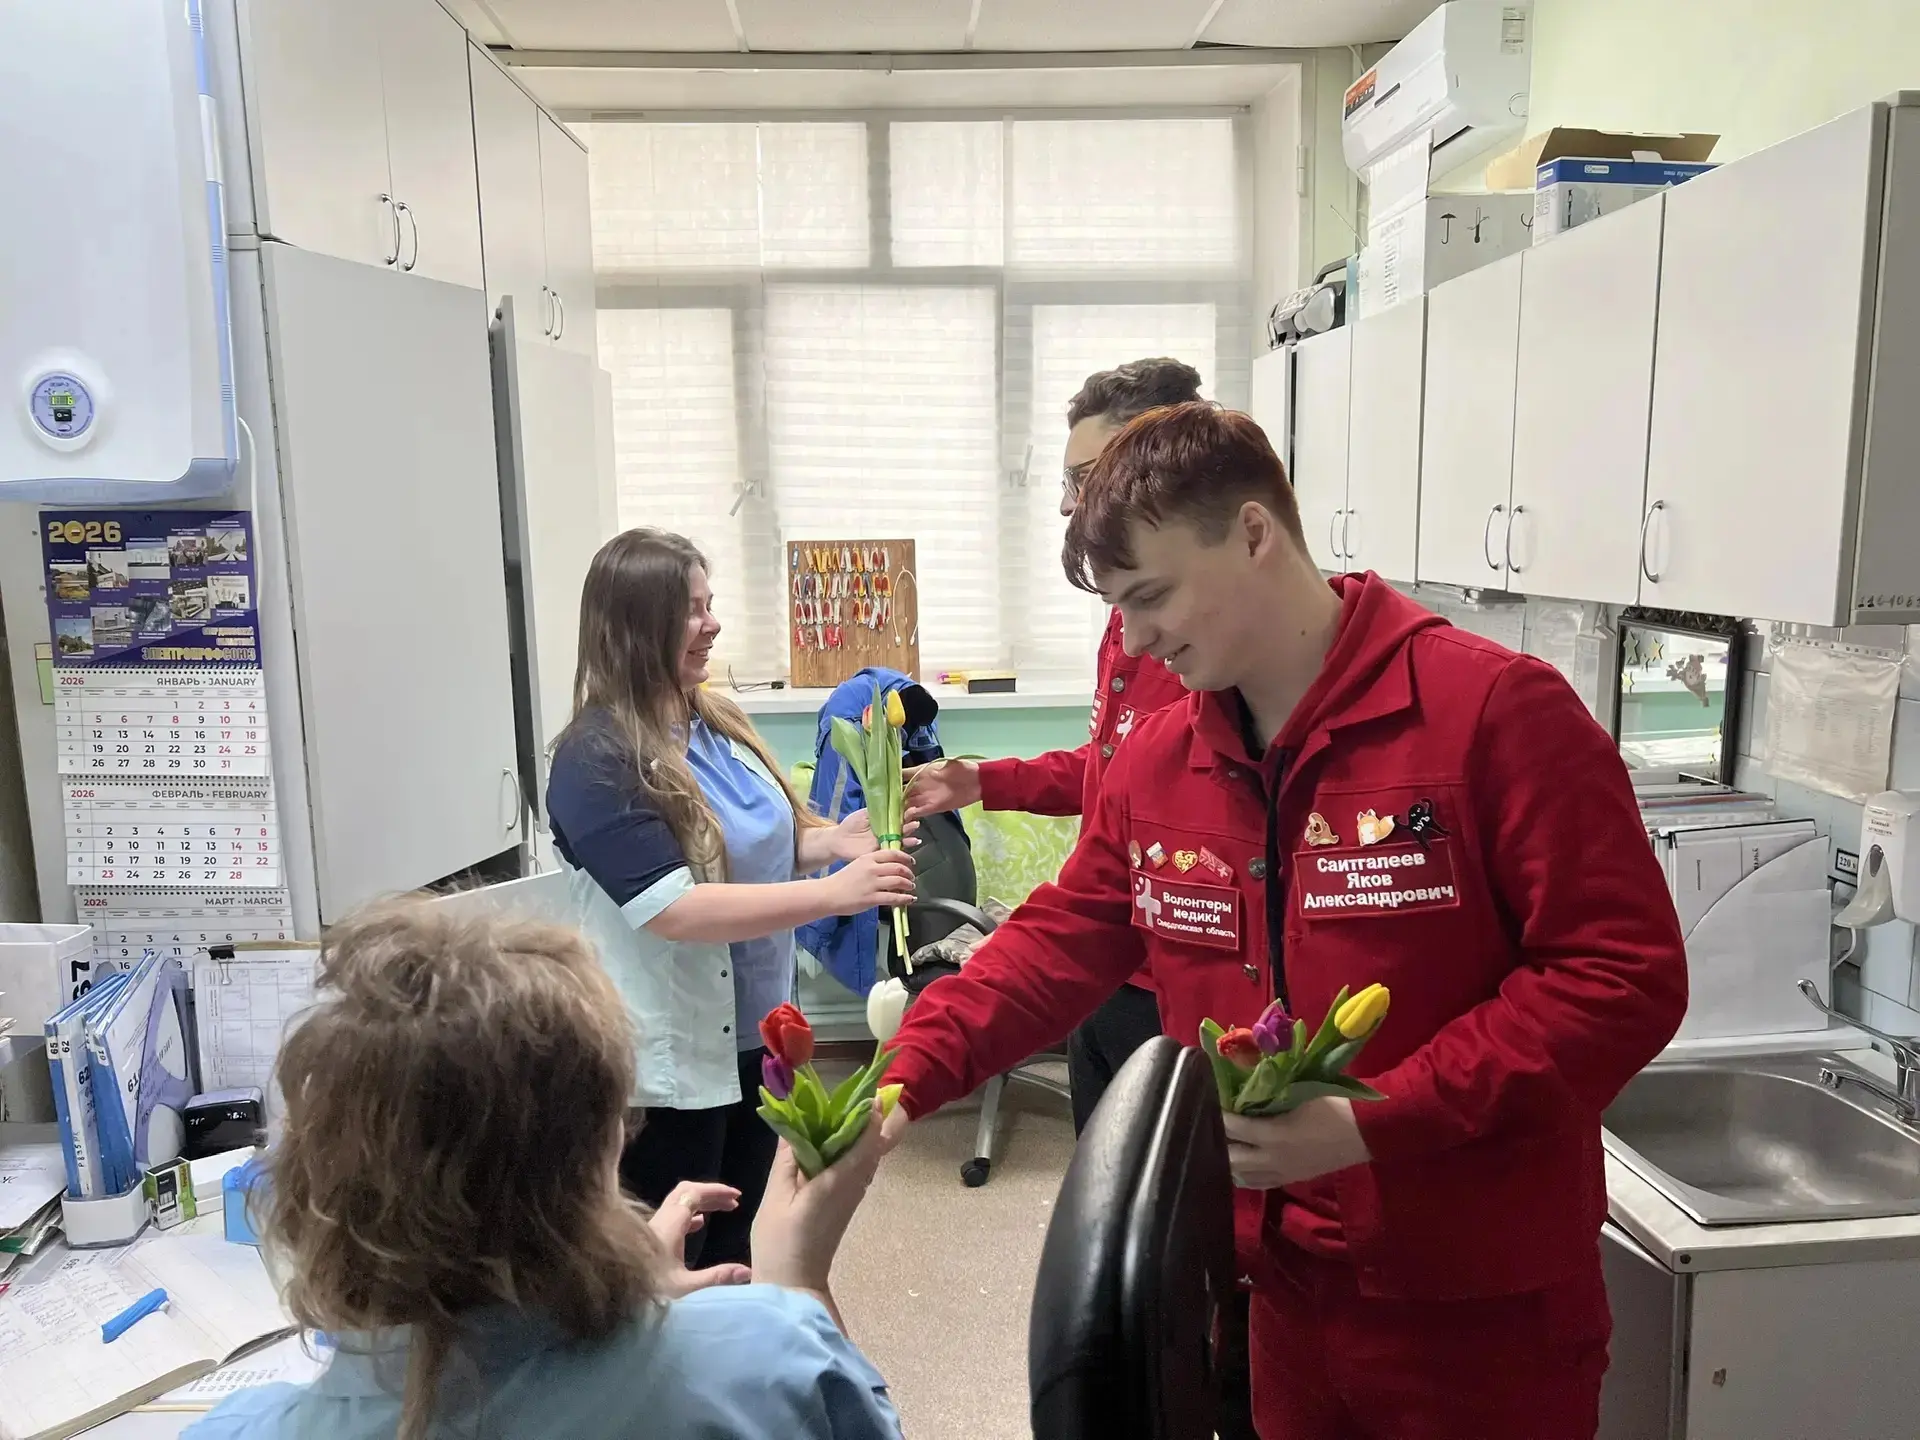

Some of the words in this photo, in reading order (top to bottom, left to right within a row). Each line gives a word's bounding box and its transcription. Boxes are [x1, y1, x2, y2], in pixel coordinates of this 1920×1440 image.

[48, 521, 121, 543] 2026
[60, 677, 85, 685] 2026
[156, 677, 200, 686] ЯНВАРЬ
[208, 677, 257, 686] JANUARY
[219, 715, 231, 725] 10
[248, 715, 257, 725] 11
[92, 729, 103, 739] 12
[117, 730, 129, 739] 13
[142, 730, 154, 739] 14
[169, 730, 180, 739] 15
[194, 730, 206, 740] 16
[220, 730, 231, 740] 17
[245, 730, 257, 740] 18
[92, 744, 104, 753] 19
[116, 744, 130, 753] 20
[144, 744, 155, 753] 21
[168, 744, 181, 754] 22
[193, 744, 206, 754] 23
[218, 745, 231, 754] 24
[244, 745, 257, 755] 25
[91, 758, 105, 768] 26
[117, 758, 130, 768] 27
[142, 759, 156, 768] 28
[168, 759, 181, 768] 29
[192, 759, 206, 769] 30
[220, 759, 231, 769] 31
[70, 789, 95, 798] 2026
[152, 789, 204, 799] ФЕВРАЛЬ
[212, 790, 268, 799] FEBRUARY
[127, 840, 140, 851] 10
[156, 841, 165, 851] 11
[180, 841, 191, 851] 12
[206, 841, 217, 851] 13
[231, 841, 243, 851] 14
[257, 841, 268, 852] 15
[103, 855, 114, 865] 16
[128, 855, 140, 865] 17
[154, 856, 166, 865] 18
[179, 856, 191, 865] 19
[203, 856, 217, 865] 20
[232, 856, 243, 866] 21
[256, 856, 269, 866] 22
[1838, 856, 1852, 868] 220
[101, 869, 114, 879] 23
[126, 869, 140, 879] 24
[152, 870, 165, 879] 25
[178, 870, 191, 880] 26
[204, 870, 217, 880] 27
[229, 870, 243, 880] 28
[1346, 872, 1393, 889] Яков
[83, 898, 108, 907] 2026
[205, 897, 235, 906] МАРТ
[244, 897, 283, 905] MARCH
[1162, 891, 1232, 914] Волонтеры
[1303, 885, 1455, 909] Александрович
[1206, 926, 1236, 938] область
[172, 947, 182, 956] 11
[119, 961, 131, 971] 16
[49, 1041, 59, 1055] 65
[61, 1040, 70, 1054] 62
